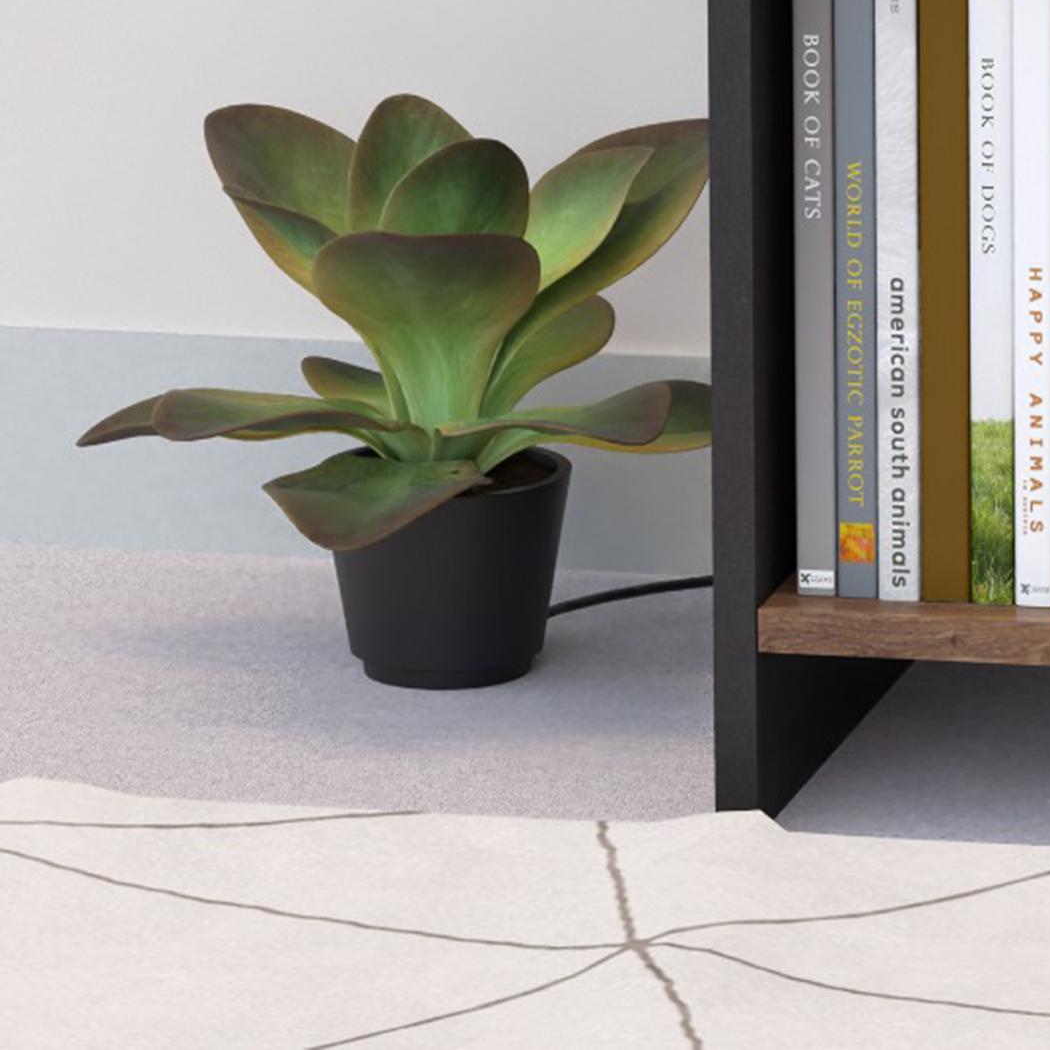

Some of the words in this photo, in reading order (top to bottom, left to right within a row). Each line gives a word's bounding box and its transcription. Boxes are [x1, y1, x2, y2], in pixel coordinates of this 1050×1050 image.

[803, 34, 820, 104] BOOK
[981, 57, 995, 128] BOOK
[803, 117, 821, 148] OF
[981, 140, 995, 173] OF
[803, 160, 822, 220] CATS
[846, 162, 864, 249] WORLD
[981, 185, 996, 255] DOGS
[846, 258, 864, 292] OF
[890, 277, 909, 398] american
[1028, 267, 1043, 367] HAPPY
[846, 300, 865, 406] EGZOTIC
[847, 416, 866, 508] PARROT
[890, 408, 911, 479] south
[1029, 393, 1044, 533] ANIMALS
[891, 488, 912, 588] animals
